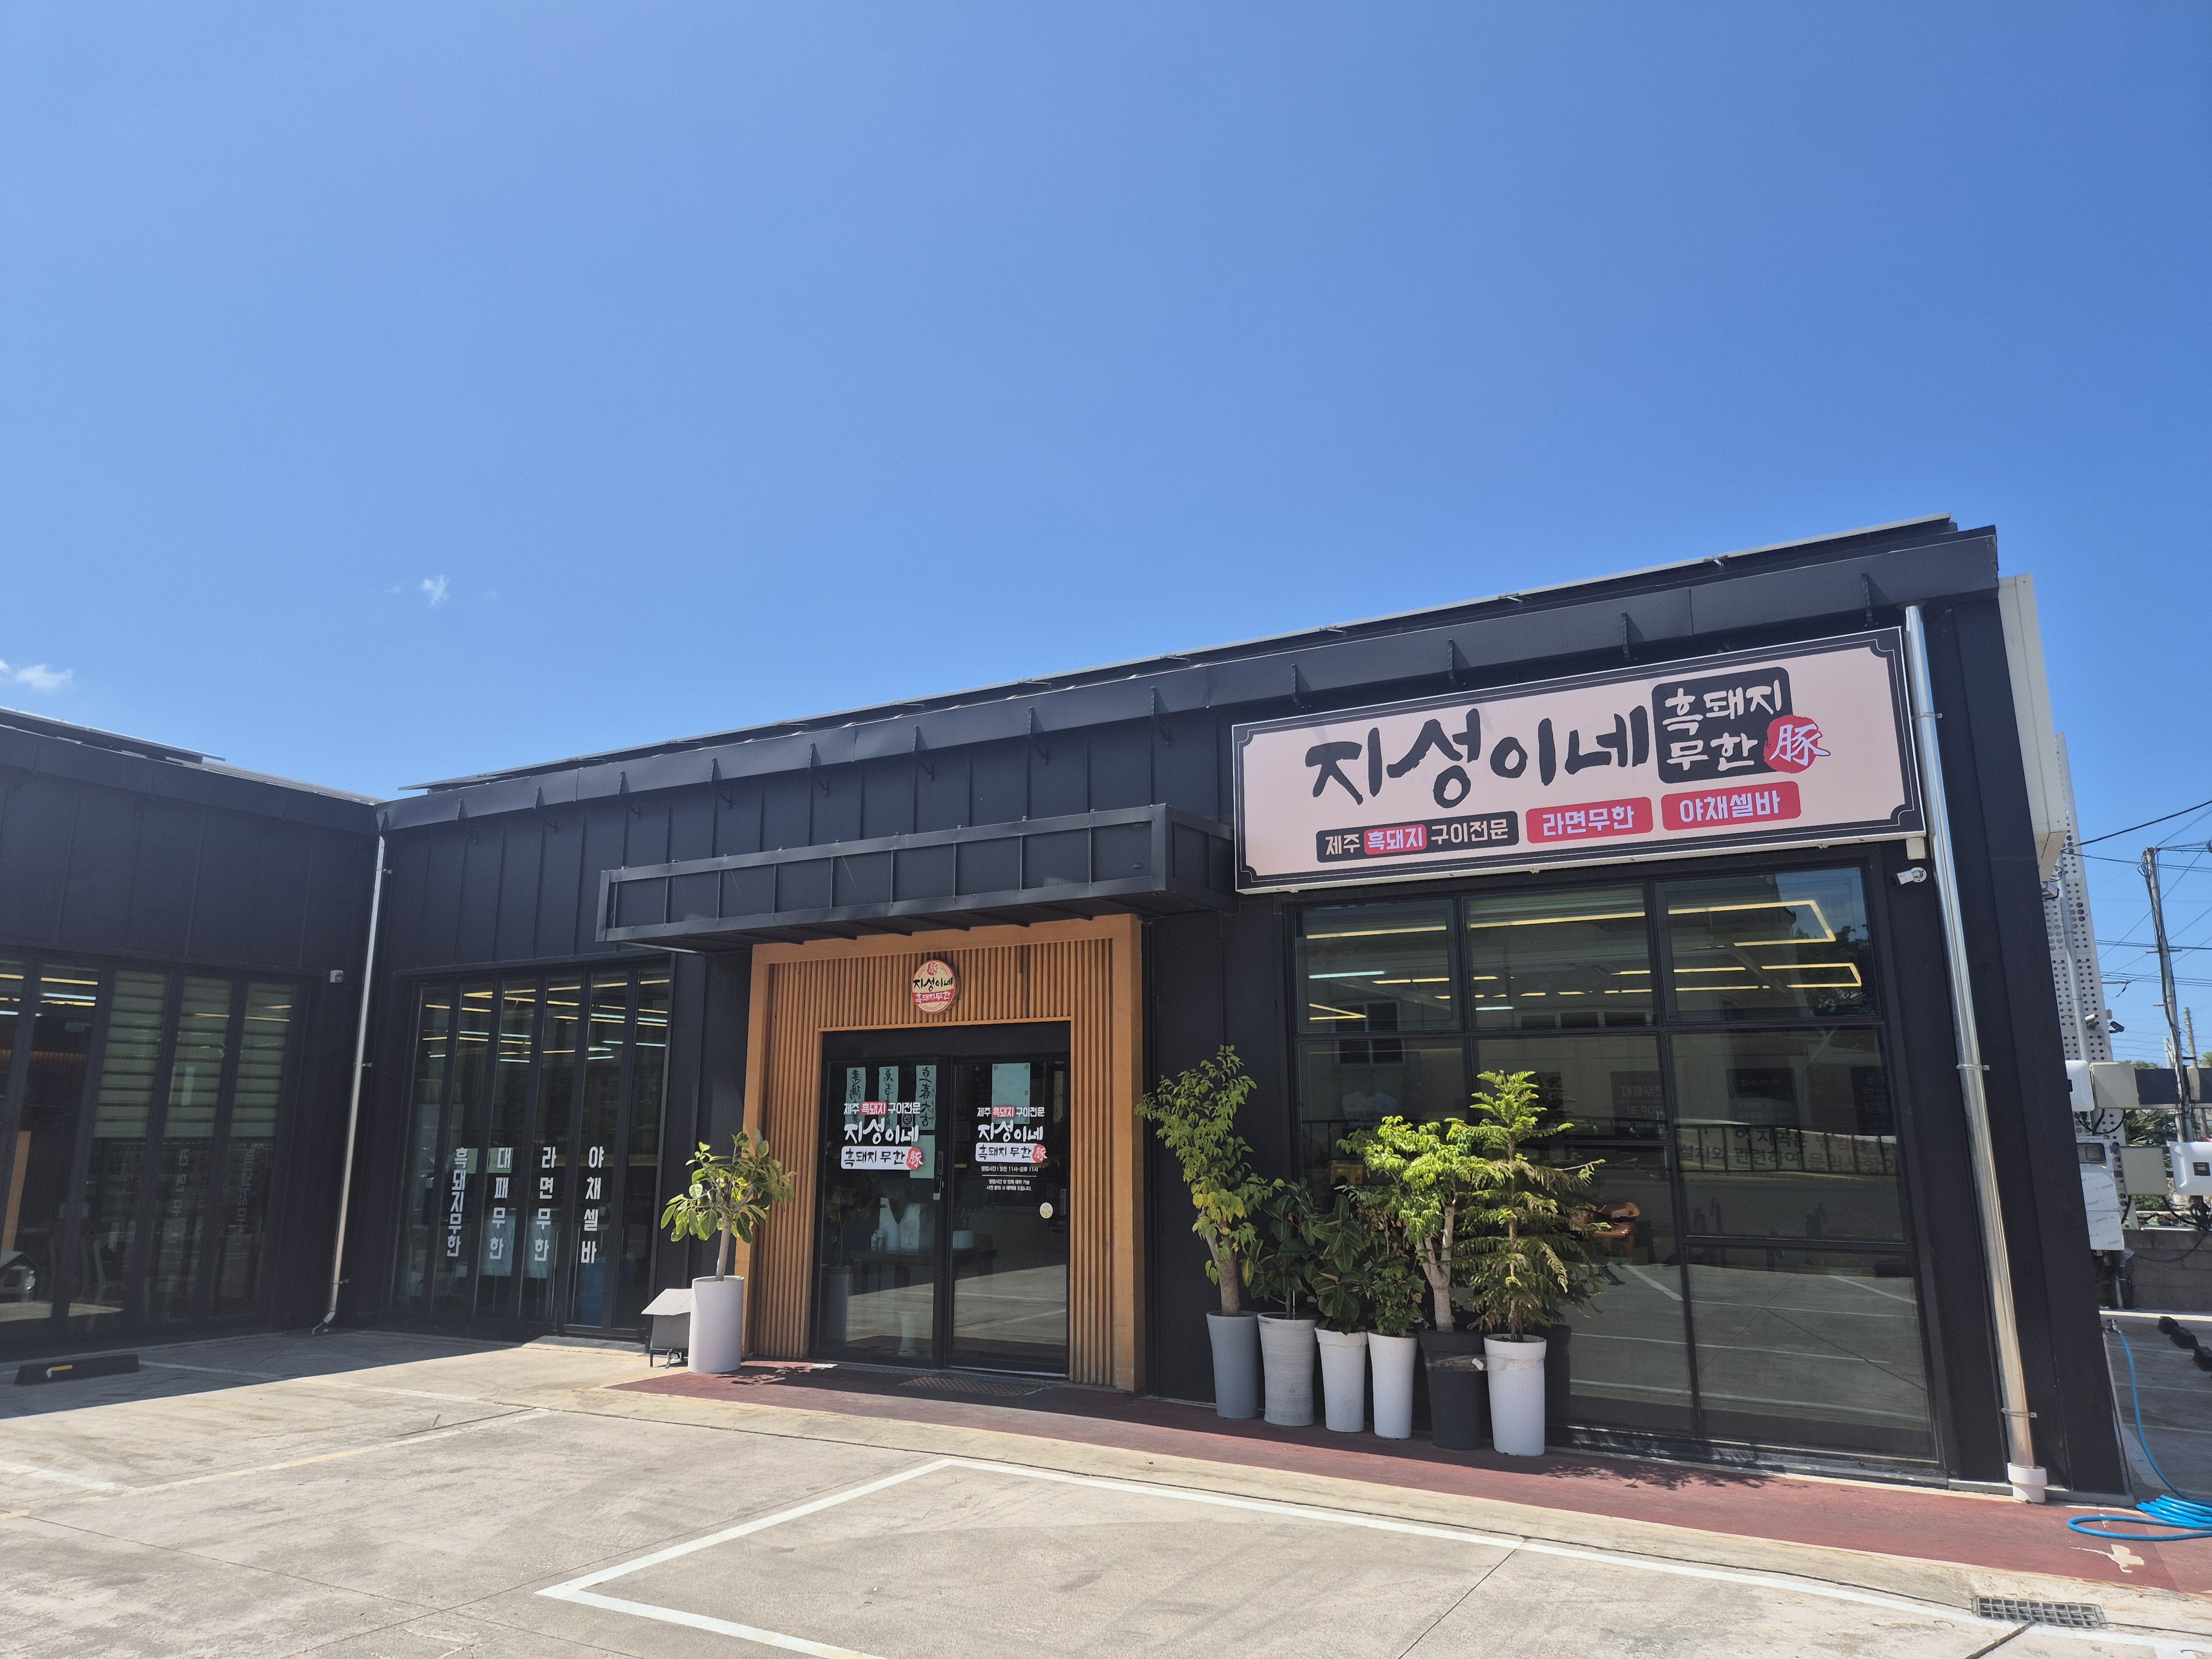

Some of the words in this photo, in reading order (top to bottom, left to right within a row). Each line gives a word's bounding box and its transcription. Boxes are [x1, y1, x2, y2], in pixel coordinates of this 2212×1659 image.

[1662, 679, 1782, 735] 흑돼지
[1305, 705, 1650, 808] 지성이네
[1666, 732, 1759, 771] 무한
[1769, 723, 1831, 766] 豚
[1542, 805, 1634, 837] 라면무한
[1679, 790, 1780, 823] 야채셀바
[1325, 833, 1360, 855] 제주
[1367, 827, 1423, 850] 흑돼지
[1431, 818, 1509, 844] 구이전문
[914, 977, 953, 992] 지성이네
[915, 991, 951, 1004] 흑돼지무한
[843, 1103, 859, 1115] 제주
[861, 1102, 885, 1114] 흑돼지
[888, 1102, 921, 1114] 구이전문
[977, 1107, 991, 1117] 제주
[993, 1107, 1014, 1117] 흑돼지
[1016, 1107, 1045, 1117] 구이전문
[844, 1117, 919, 1145] 지성이네
[978, 1119, 1043, 1142] 지성이네
[844, 1148, 877, 1168] 흑돼지
[880, 1150, 906, 1165] 무한
[907, 1151, 924, 1168] 豚
[978, 1144, 1006, 1160] 흑돼지
[1010, 1146, 1032, 1159] 무한
[447, 1147, 468, 1258] 흑돼지무한
[489, 1147, 512, 1260] 대패무한
[534, 1146, 557, 1261] 라면무한
[581, 1146, 604, 1264] 야채셀바
